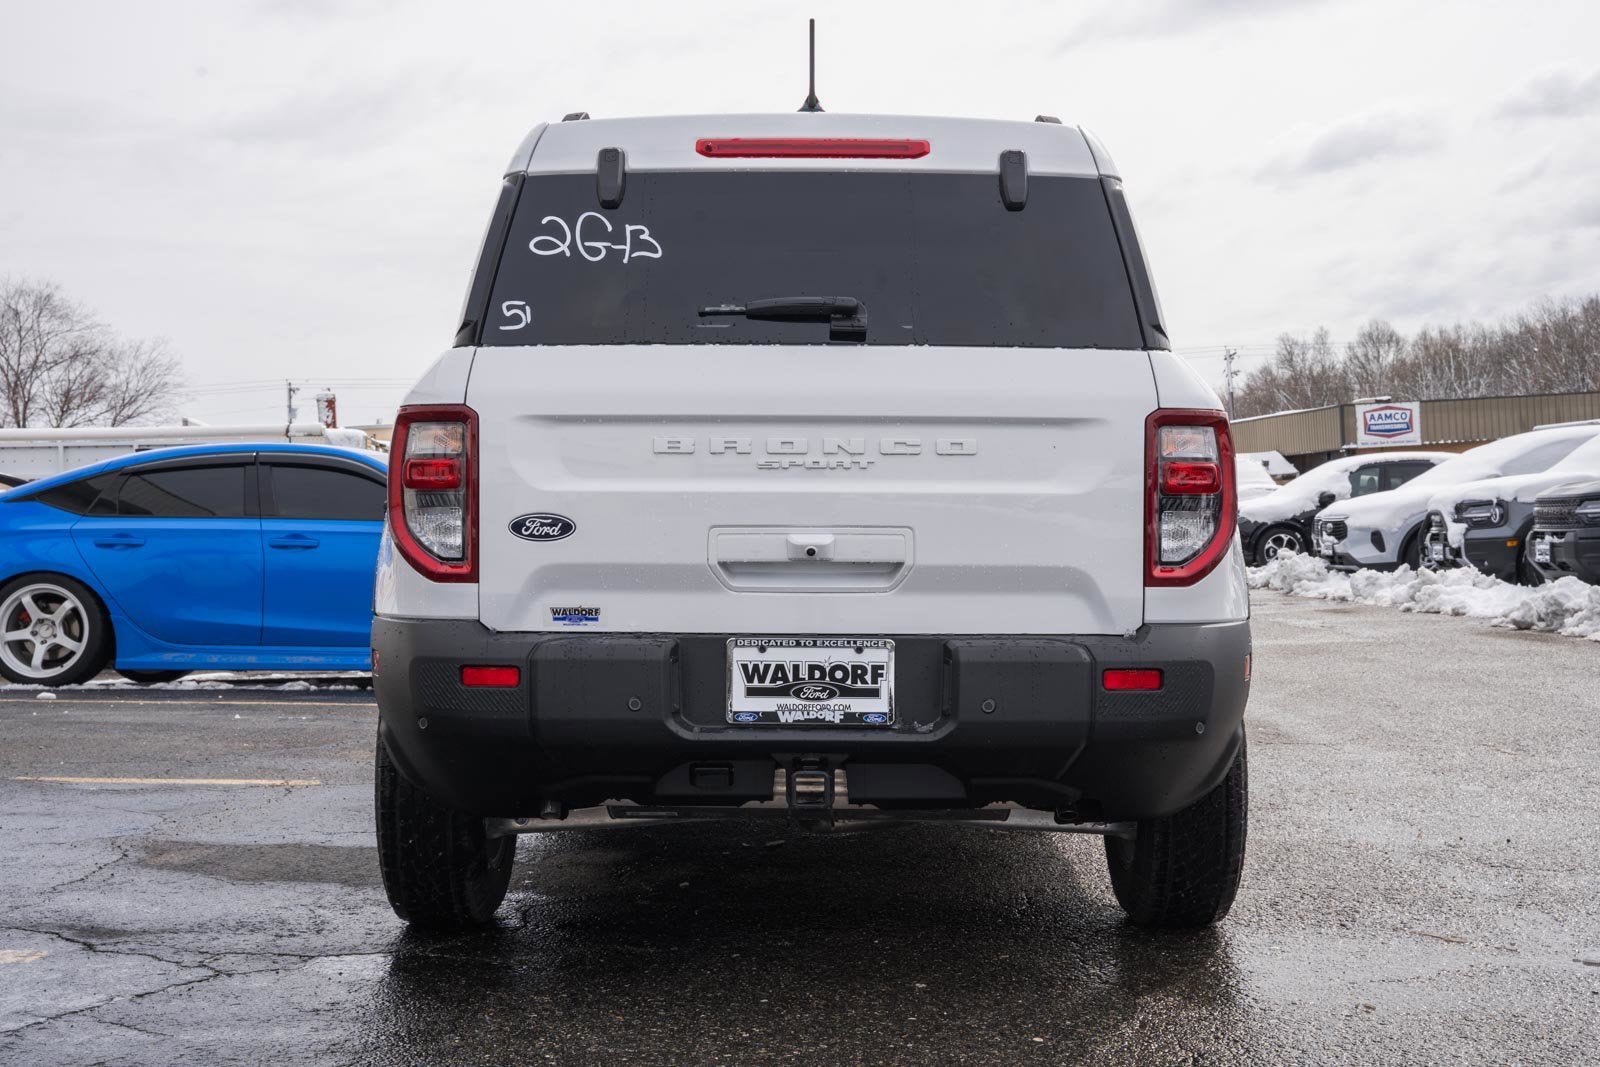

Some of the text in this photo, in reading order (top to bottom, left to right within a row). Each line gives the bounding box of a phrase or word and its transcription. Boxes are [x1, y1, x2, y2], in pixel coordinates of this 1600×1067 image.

[1369, 412, 1408, 422] AAMCO
[653, 437, 978, 456] BRONCO
[757, 459, 876, 470] SPORT
[521, 517, 562, 536] Ford
[551, 607, 601, 616] WALDORF
[737, 639, 885, 647] DEDICATED TO EXCELLENCE
[740, 662, 886, 685] WALDORF
[799, 686, 830, 700] Ford
[776, 709, 845, 724] WALDORF
